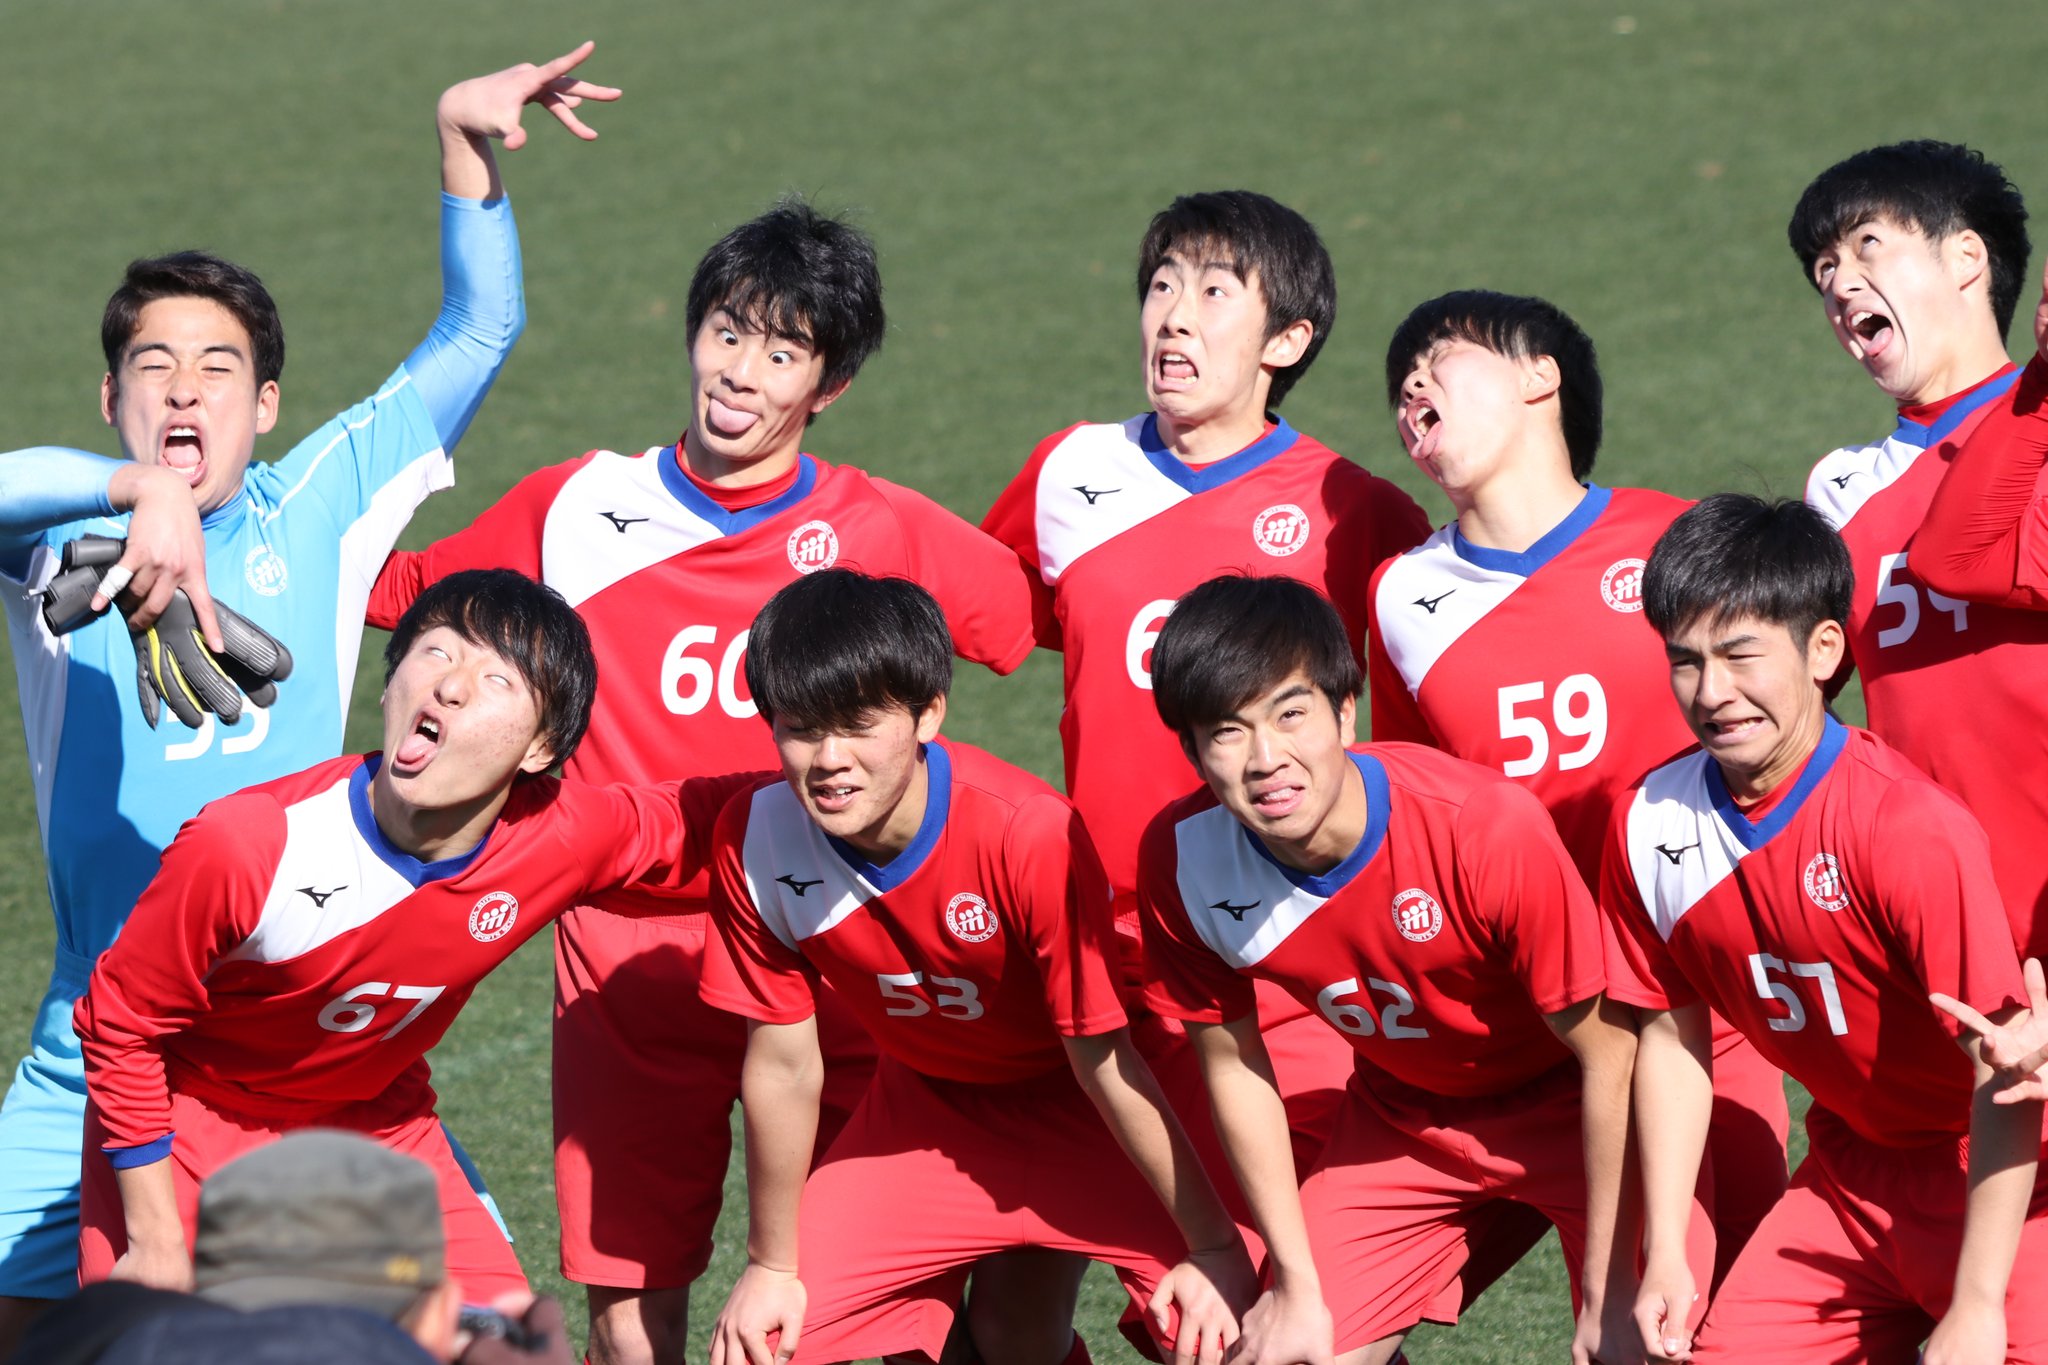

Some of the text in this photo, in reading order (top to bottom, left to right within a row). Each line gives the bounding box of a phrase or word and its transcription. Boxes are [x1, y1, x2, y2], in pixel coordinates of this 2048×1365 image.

[660, 625, 758, 718] 60
[1497, 673, 1609, 778] 59
[317, 981, 447, 1042] 67
[877, 969, 984, 1021] 53
[1317, 976, 1430, 1039] 62
[1746, 952, 1850, 1037] 57
